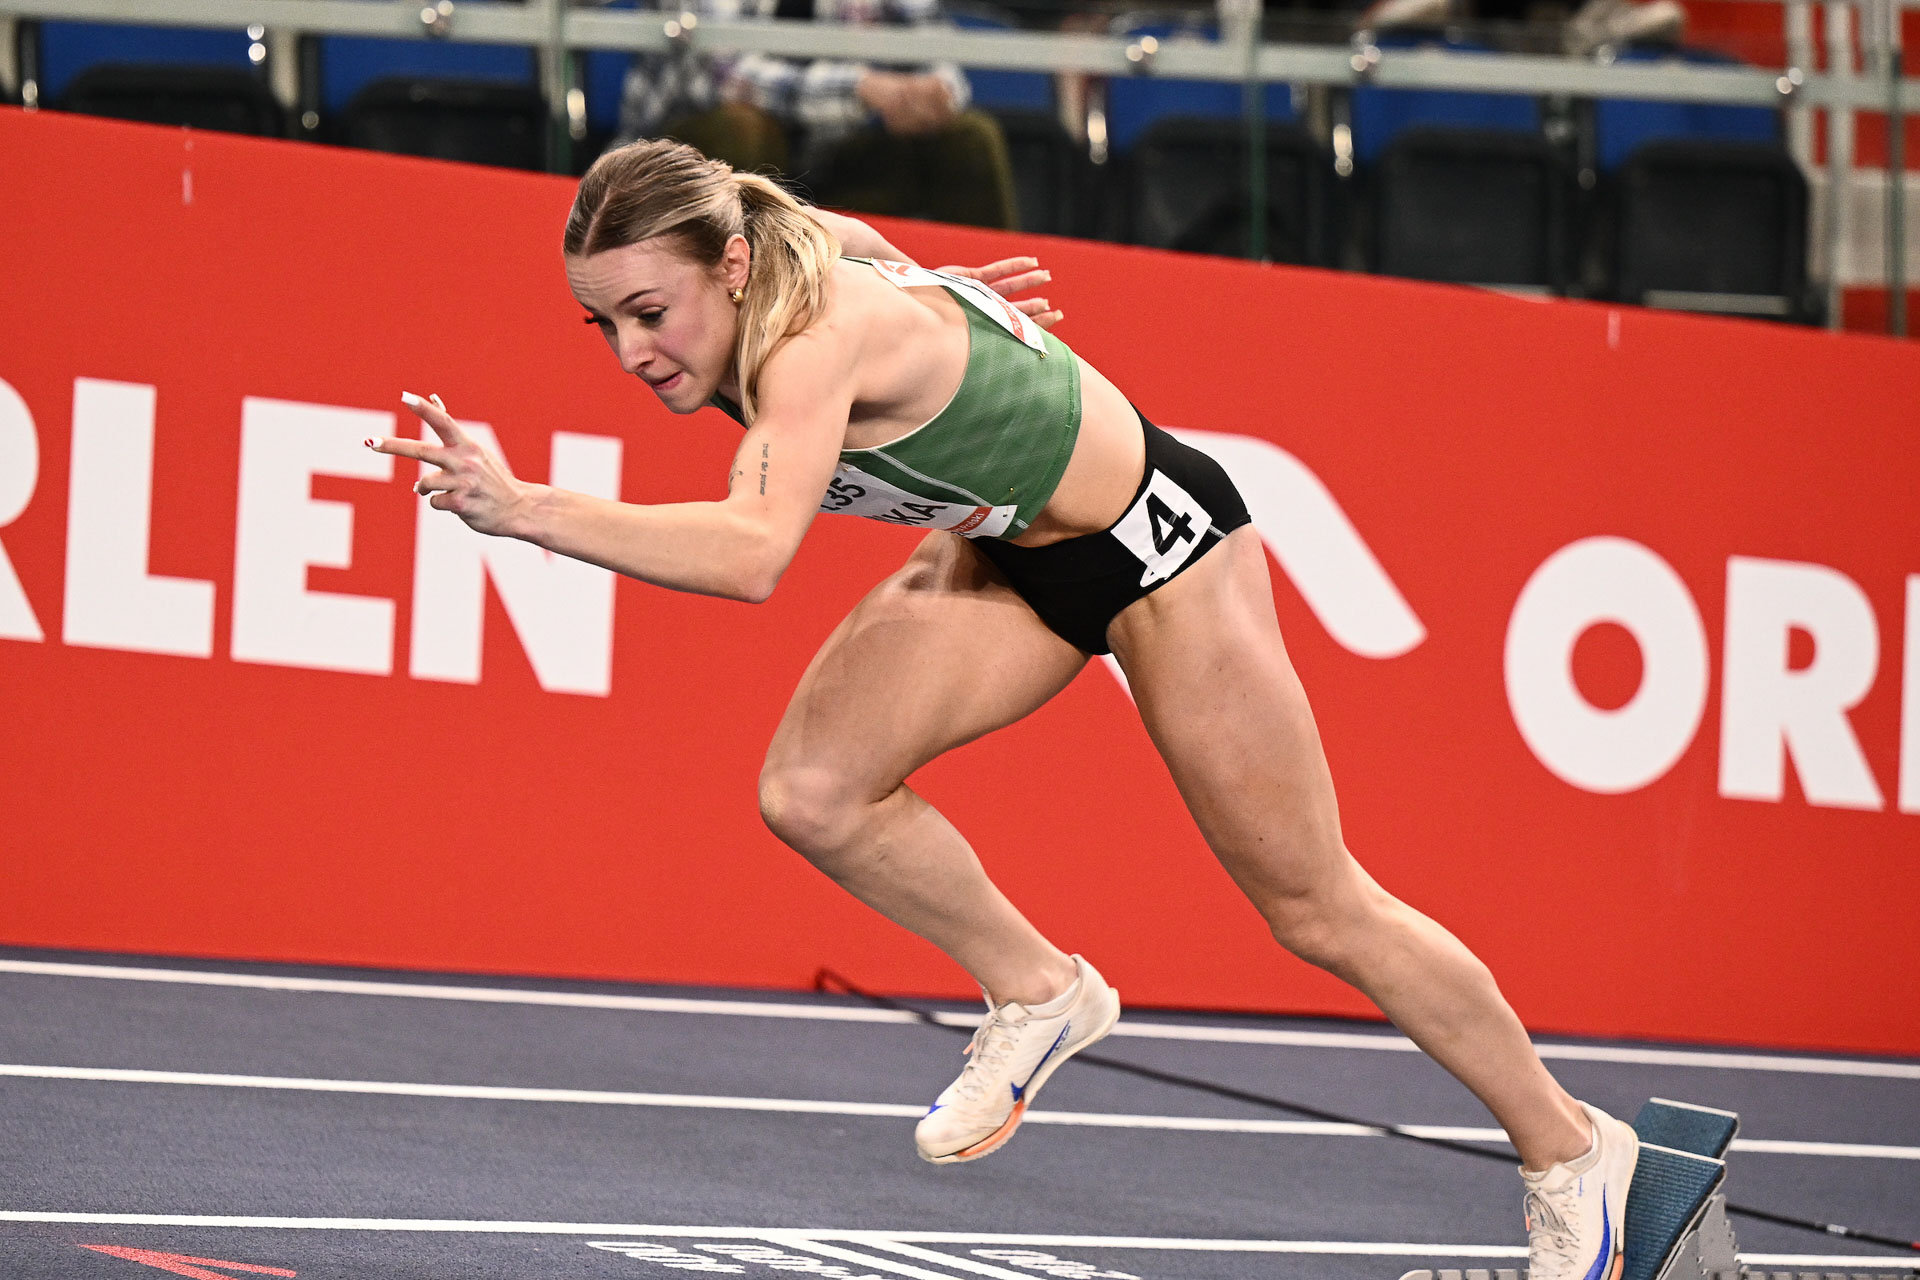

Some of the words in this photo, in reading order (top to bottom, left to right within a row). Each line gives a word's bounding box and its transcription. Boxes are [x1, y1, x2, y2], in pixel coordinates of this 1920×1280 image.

[0, 376, 624, 698] LEN
[1145, 491, 1197, 557] 4
[1502, 534, 1920, 815] OR
